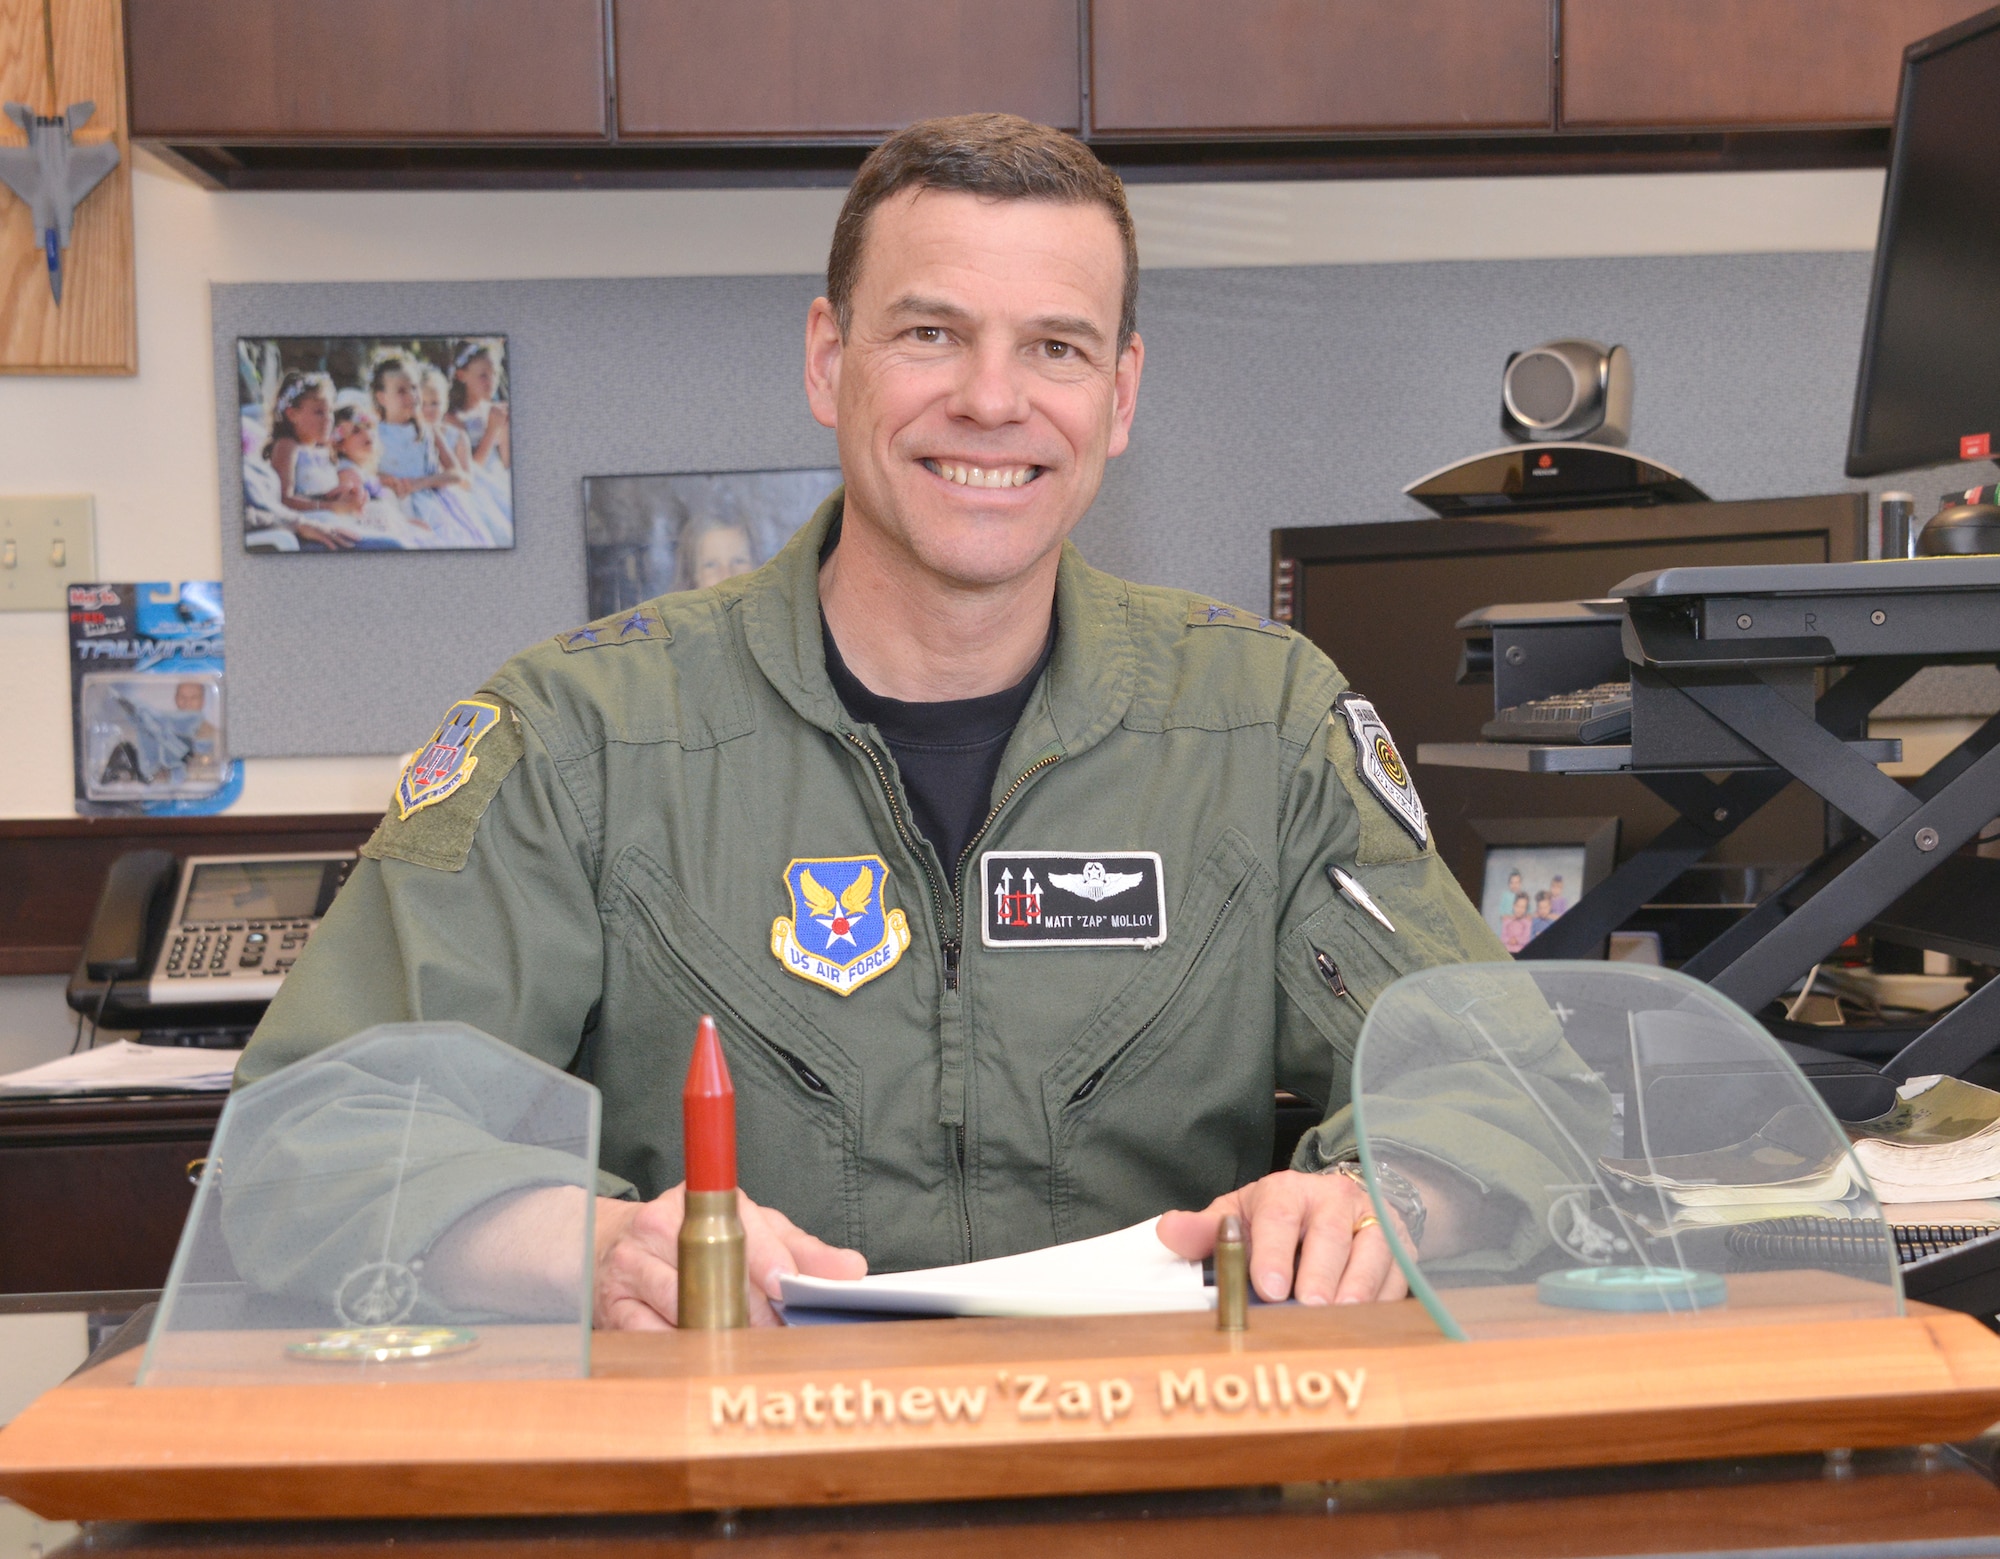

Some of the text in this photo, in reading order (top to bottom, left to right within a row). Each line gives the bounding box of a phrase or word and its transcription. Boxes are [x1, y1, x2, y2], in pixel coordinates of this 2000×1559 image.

[1805, 613, 1817, 632] R
[1045, 914, 1153, 929] MATT "ZAP" MOLLOY
[790, 944, 891, 983] US AIR FORCE
[709, 1378, 988, 1426] Matthew
[1158, 1363, 1367, 1412] Molloy
